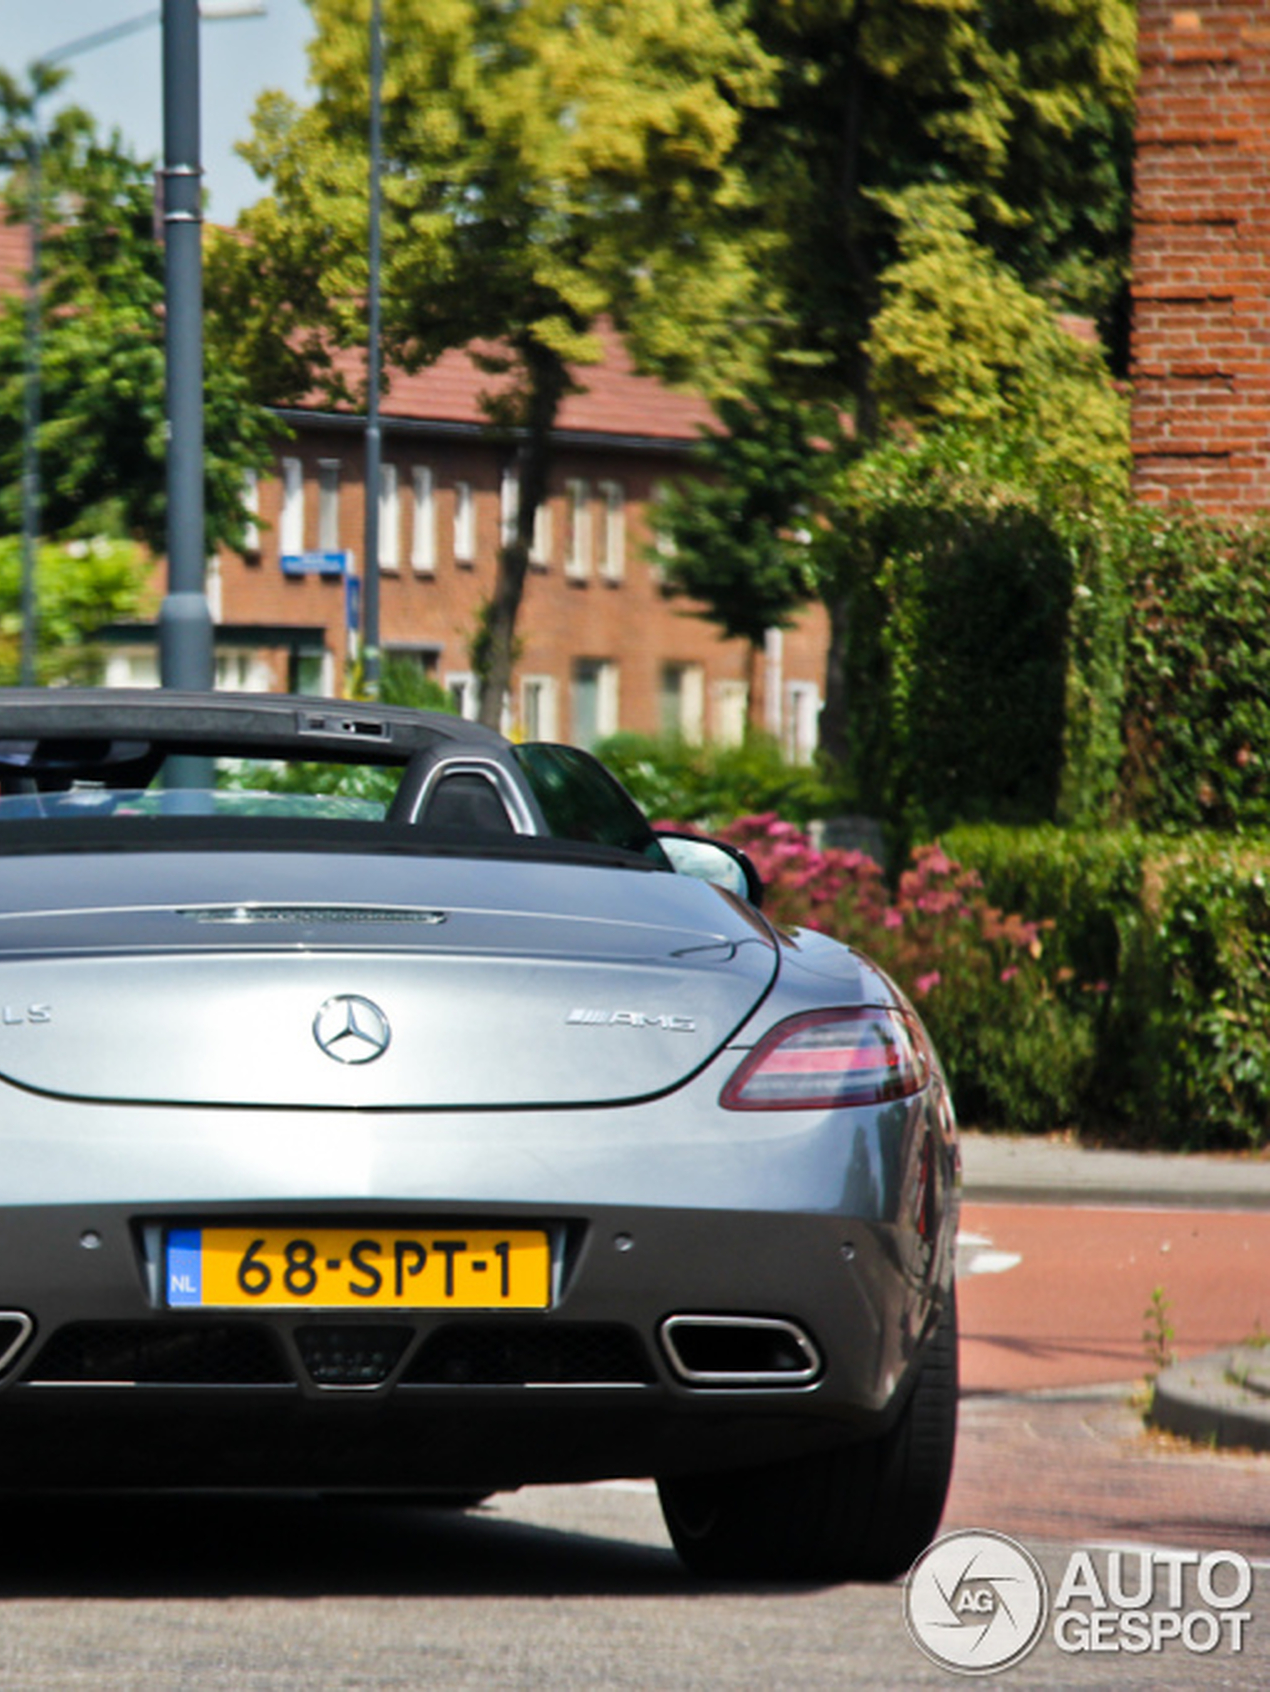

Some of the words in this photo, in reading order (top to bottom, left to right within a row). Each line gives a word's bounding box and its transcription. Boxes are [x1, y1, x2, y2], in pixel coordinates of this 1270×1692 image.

[608, 1010, 696, 1033] AMG
[237, 1239, 511, 1298] 68-SPT-1
[171, 1275, 197, 1293] NL
